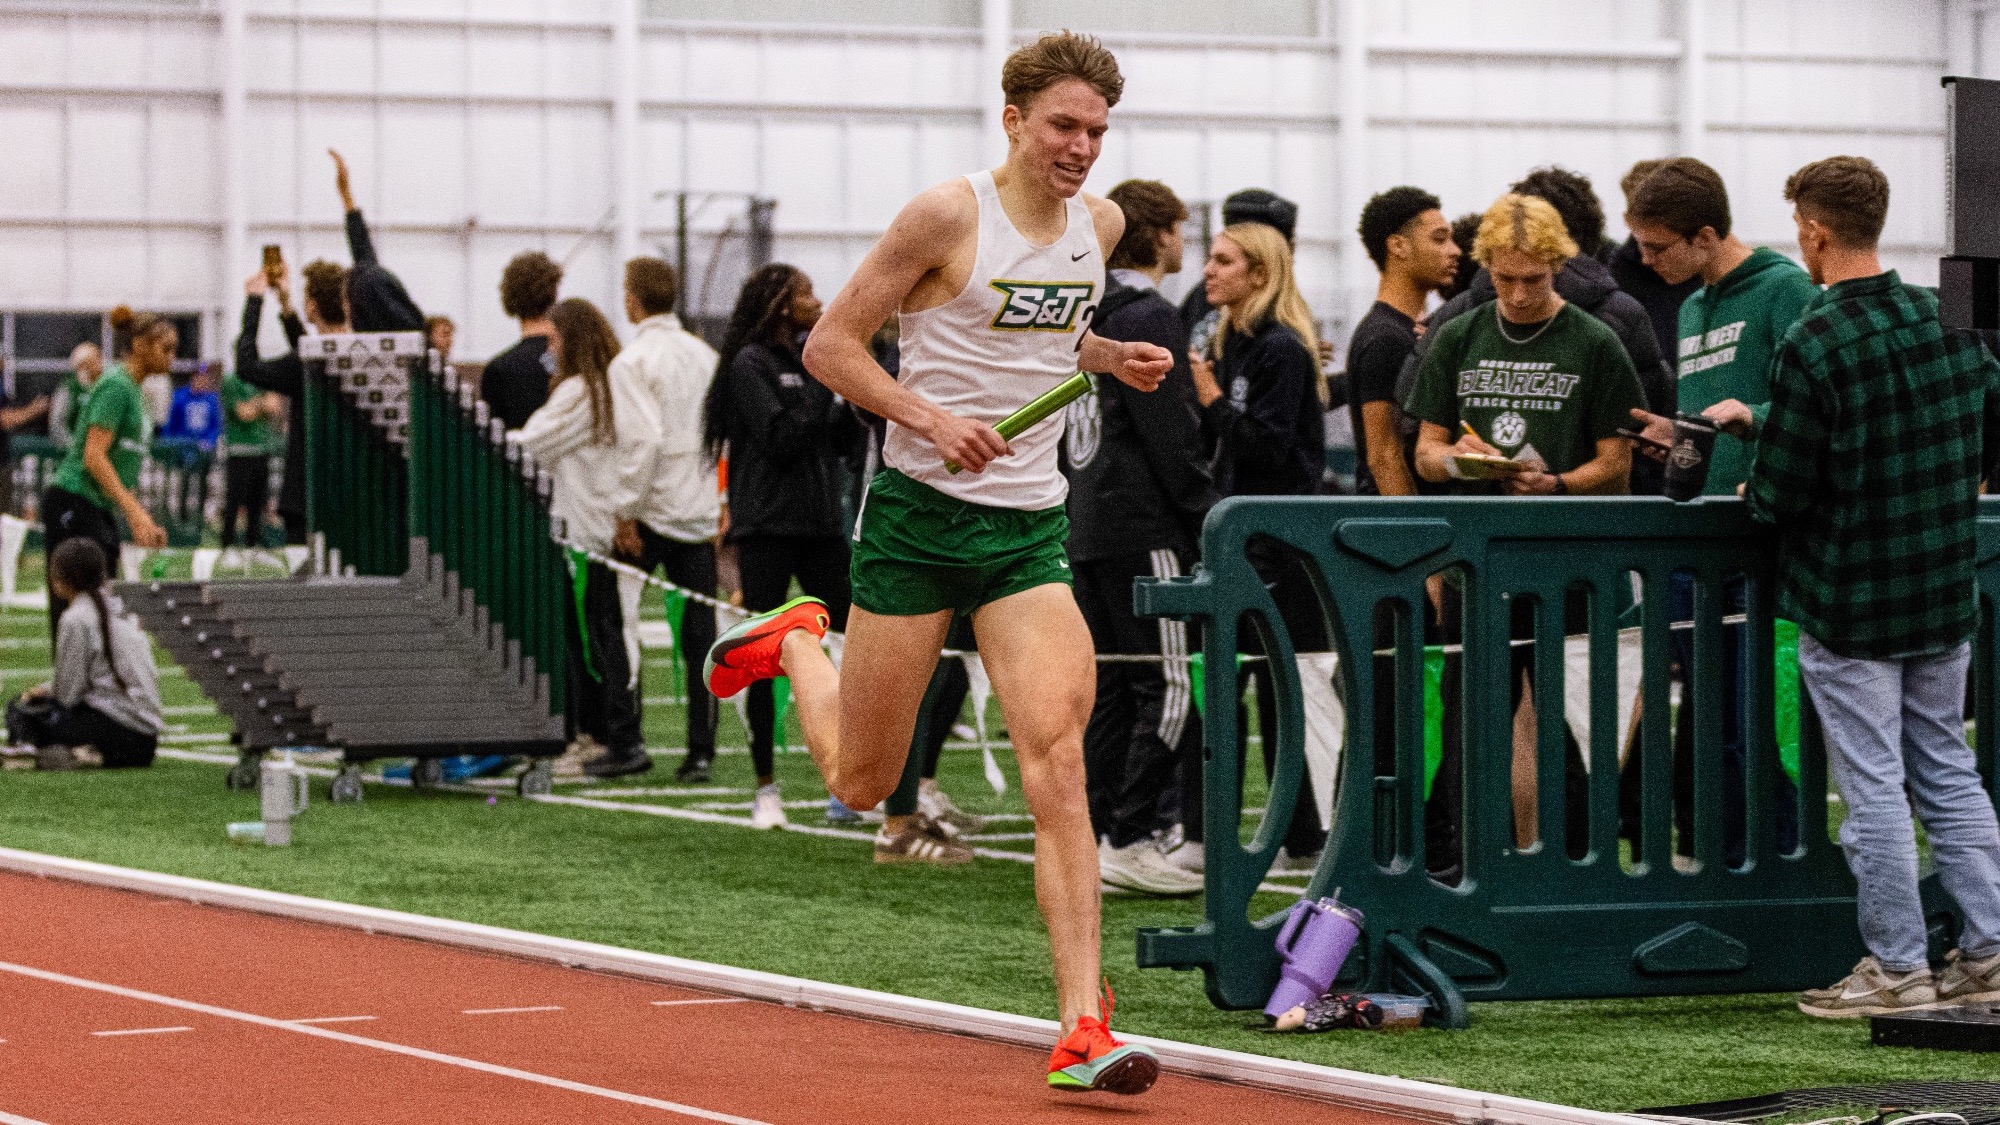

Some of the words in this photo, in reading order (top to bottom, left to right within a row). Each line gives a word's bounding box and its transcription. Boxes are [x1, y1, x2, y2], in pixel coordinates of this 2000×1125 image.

[997, 284, 1090, 328] S&T
[1457, 370, 1580, 398] BEARCAT
[1465, 398, 1509, 408] TRACK
[1522, 400, 1562, 410] FIELD
